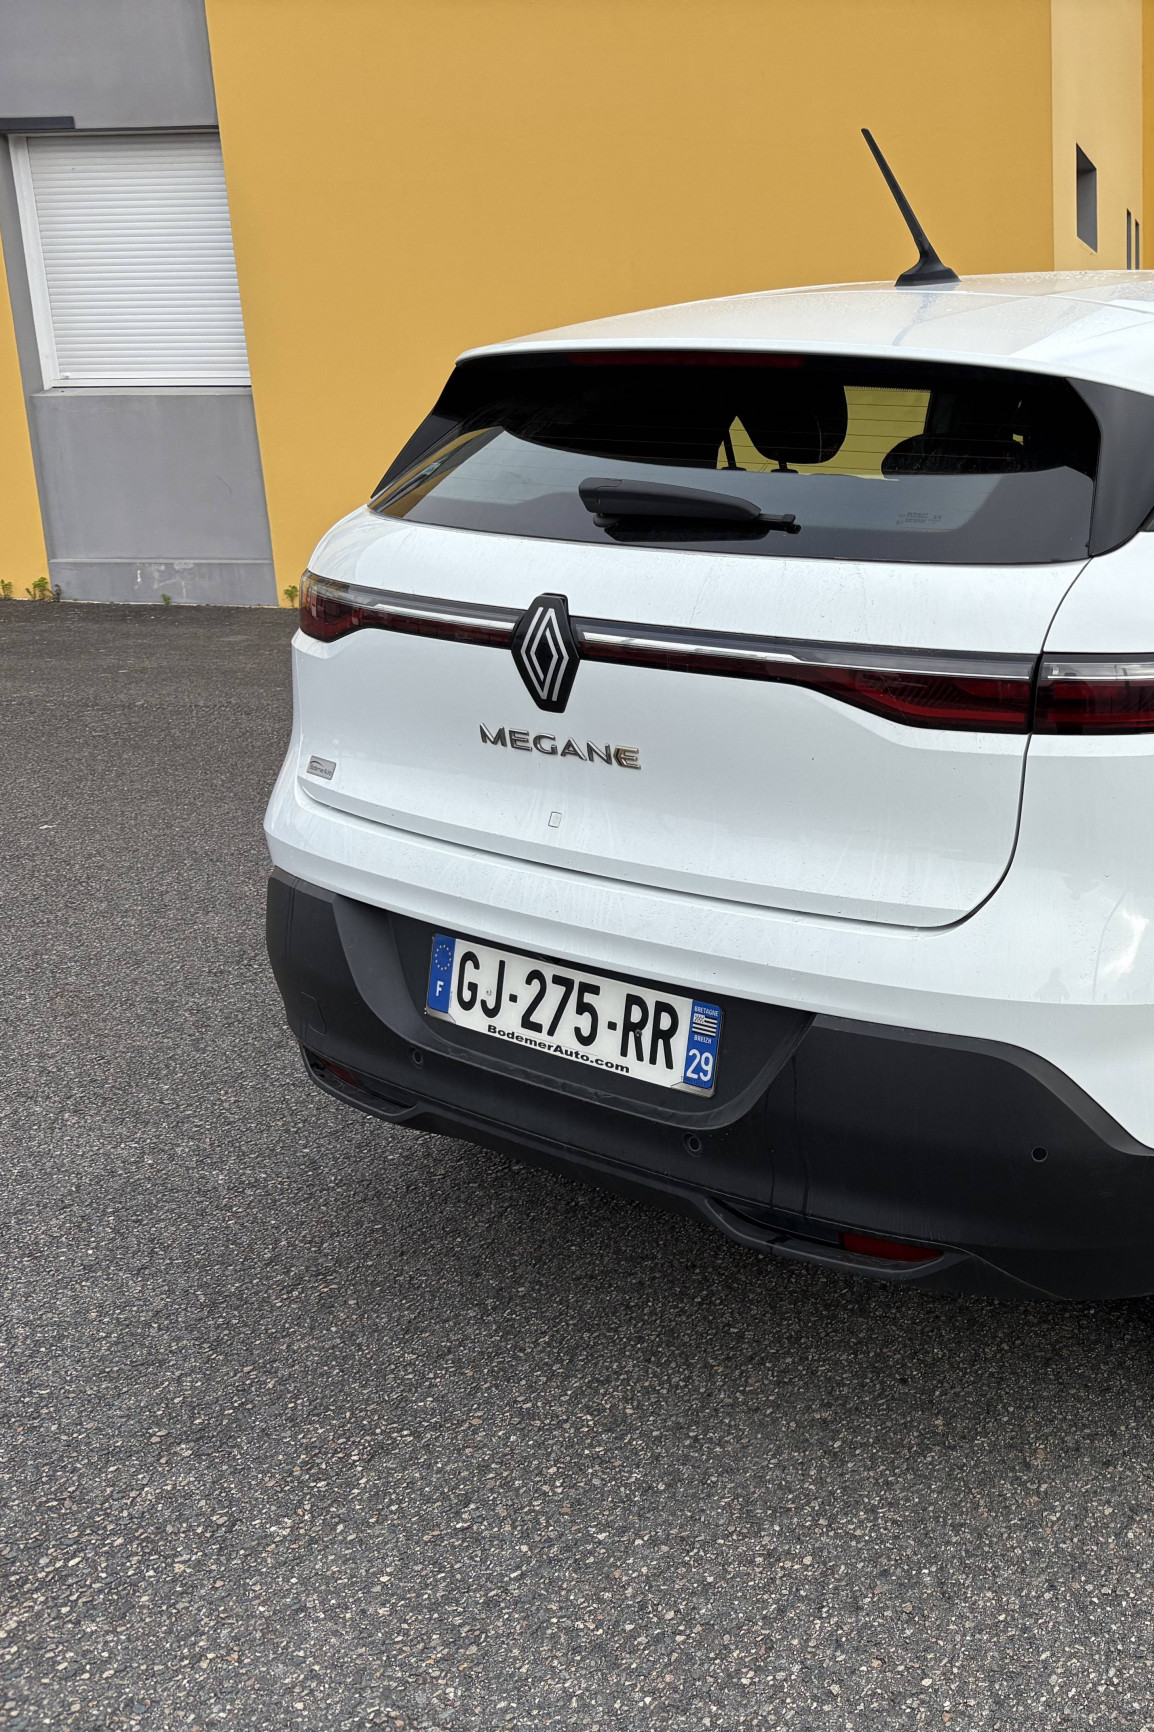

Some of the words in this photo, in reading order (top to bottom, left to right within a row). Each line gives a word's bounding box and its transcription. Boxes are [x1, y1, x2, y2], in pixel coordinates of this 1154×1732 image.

[479, 722, 641, 770] MEGANE
[436, 980, 445, 997] F
[456, 950, 680, 1071] GJ-275-RR
[693, 1005, 719, 1017] BRETAGNE
[487, 1024, 630, 1074] BodemerAuto.com
[686, 1048, 714, 1082] 29
